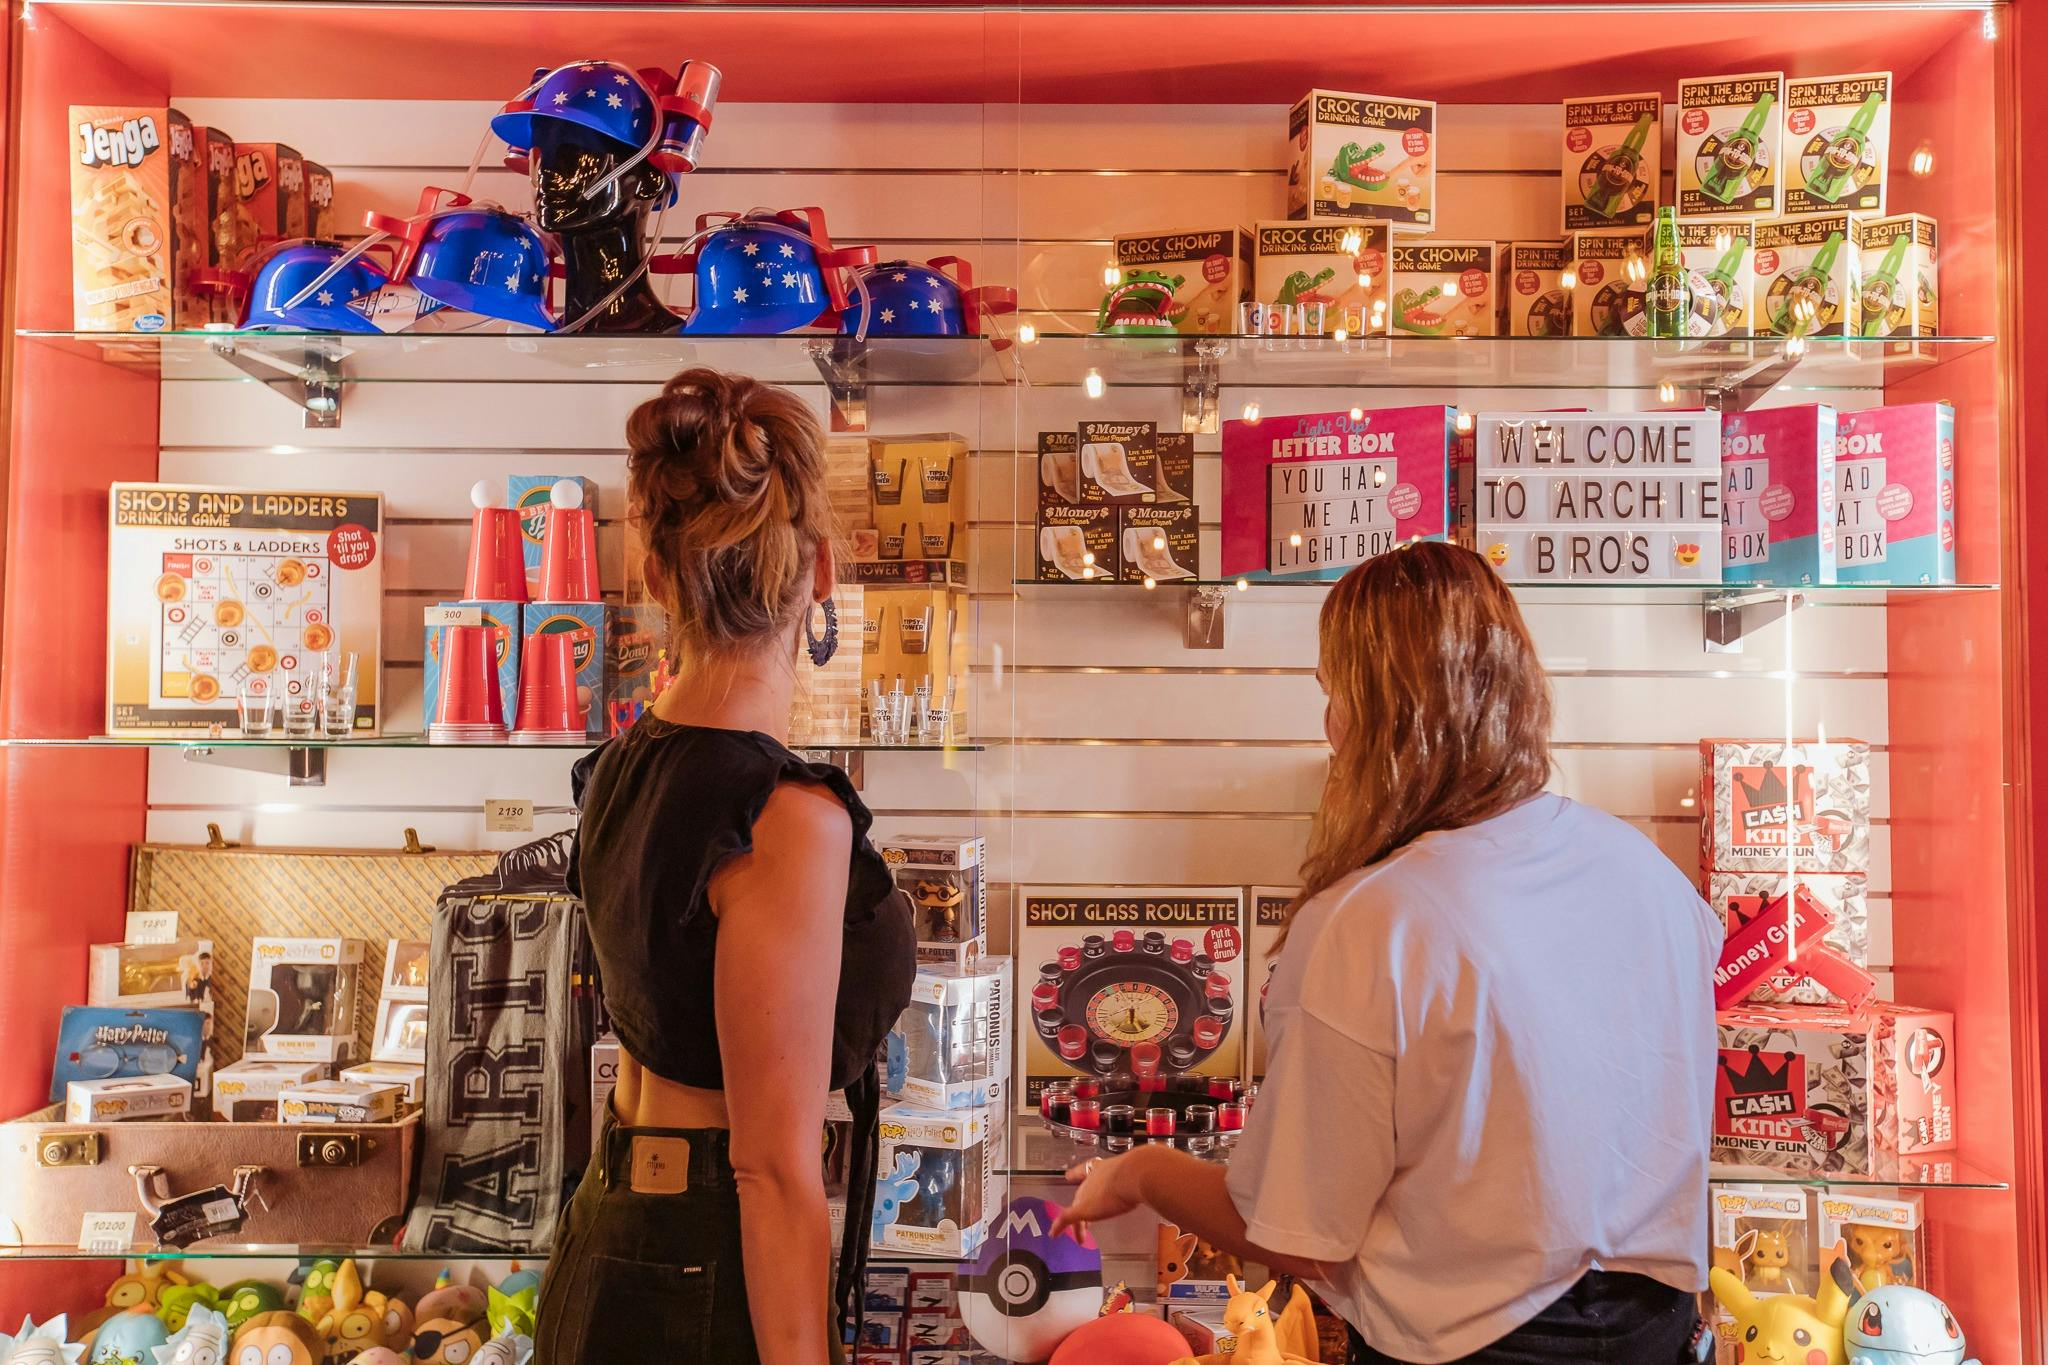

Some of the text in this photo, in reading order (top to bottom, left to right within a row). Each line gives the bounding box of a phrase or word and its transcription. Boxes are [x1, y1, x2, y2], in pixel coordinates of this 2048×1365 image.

[1684, 80, 1776, 98] SPIN THE BOTTLE
[1791, 79, 1885, 98] SPIN THE BOTTLE
[1684, 93, 1752, 106] DRINKING GAME
[1790, 93, 1861, 106] DRINKING GAME
[1318, 98, 1421, 121] CROC CHOMP
[1568, 101, 1656, 116] SPIN THE BOTTLE
[1318, 112, 1386, 127] DRINKING GAME
[1568, 113, 1633, 124] DRINKING GAME
[79, 115, 160, 167] Jenga
[1684, 192, 1700, 201] SET
[1788, 192, 1804, 200] SET
[1568, 208, 1584, 216] SET
[1689, 225, 1750, 236] THE BOTTLE
[1755, 220, 1846, 238] SPIN THE BOTTLE
[1871, 222, 1912, 237] BOTTLE
[1120, 233, 1222, 255] CROC CHOMP
[1262, 230, 1306, 244] CROC
[1580, 239, 1604, 248] SPIN
[1607, 239, 1624, 248] THE
[1798, 232, 1822, 242] GAME
[1865, 236, 1888, 248] GAME
[1262, 243, 1335, 254] DRINKING GAME
[1393, 248, 1478, 262] OC CHOMP
[1517, 250, 1560, 259] SPIN THE
[1580, 249, 1618, 257] DRINKING
[1120, 251, 1186, 264] DRINKING GAME
[1417, 262, 1442, 270] GAME
[1086, 424, 1150, 436] $Money$
[1293, 418, 1334, 442] Light
[1272, 432, 1395, 458] LETTER BOX
[1500, 425, 1692, 464] WELCOME
[1722, 433, 1766, 456] BOX
[1836, 432, 1882, 456] BOX
[1282, 465, 1382, 494] YOU HAD
[1728, 467, 1753, 492] AD
[1844, 466, 1870, 492] AD
[119, 491, 348, 518] SHOTS AND LADDERS
[1484, 481, 1526, 519] TO
[1556, 481, 1718, 519] ARCHIE
[118, 510, 231, 527] DRINKING GAME
[1045, 507, 1109, 520] $Money$
[1128, 508, 1192, 520] $Money$
[1303, 502, 1332, 528] ME
[1350, 499, 1374, 524] AT
[1721, 501, 1744, 526] AT
[1837, 501, 1862, 526] AT
[1070, 518, 1090, 526] Paper
[337, 529, 361, 542] Shot
[174, 538, 320, 554] SHOTS & LADDERS
[333, 541, 370, 556] 'til you
[339, 552, 368, 565] drop!
[1537, 535, 1650, 574] BROS
[859, 564, 900, 576] TOWER
[444, 610, 462, 620] 300
[498, 807, 524, 816] 2130
[882, 851, 908, 864] POP!
[942, 854, 953, 863] 26
[1732, 847, 1781, 856] MONEY
[1030, 903, 1236, 921] SHOT GLASS ROULETTE
[1211, 927, 1230, 940] Put it
[1213, 939, 1234, 949] all on
[928, 948, 954, 956] POTTER
[1214, 947, 1236, 960] drunk
[1713, 940, 1770, 987] Money
[1782, 978, 1810, 987] GUN
[988, 978, 1000, 1048] PATRONUS
[96, 1024, 169, 1045] Harry Potter
[1029, 1081, 1044, 1089] SET
[1730, 1094, 1791, 1116] CA$H
[1932, 1082, 1942, 1143] MONEY
[1731, 1118, 1792, 1138] KING
[1942, 1105, 1952, 1141] GUN
[880, 1123, 906, 1139] POP!
[1715, 1135, 1807, 1154] MONEY GUN
[1717, 1195, 1748, 1210] POP!
[93, 1221, 126, 1230] 10200
[896, 1230, 935, 1241] PATRONUS
